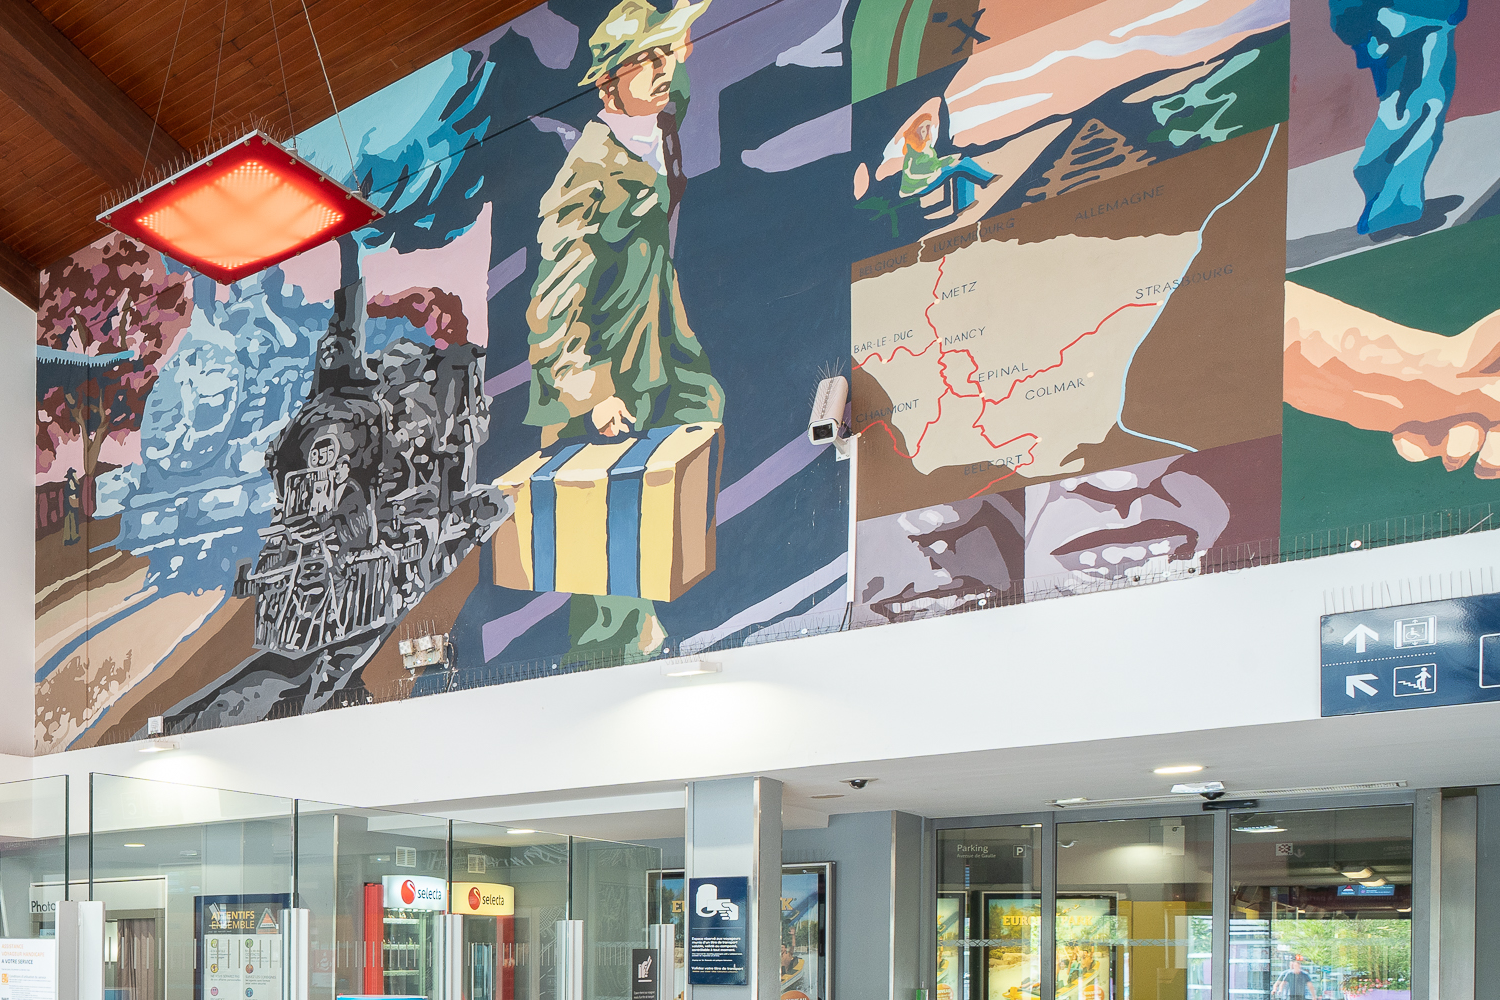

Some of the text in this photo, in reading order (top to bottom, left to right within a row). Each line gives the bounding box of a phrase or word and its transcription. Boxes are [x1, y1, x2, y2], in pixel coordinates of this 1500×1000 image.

[1074, 184, 1165, 223] ALLEMAGNE
[933, 217, 1016, 254] LUXEMBOURG
[858, 252, 909, 278] BELGIQUE
[941, 281, 977, 300] METZ
[1135, 265, 1234, 299] STRASBOURG
[944, 327, 986, 346] NANCY
[977, 361, 1029, 383] EPINAL
[1024, 378, 1085, 401] COLMAR
[855, 398, 919, 424] CHAUMONT
[963, 454, 1022, 476] BELFORT
[957, 844, 1023, 855] Parking P
[417, 888, 442, 900] selecta
[482, 894, 504, 906] selecta
[211, 921, 255, 929] ENEMBLE
[1061, 916, 1093, 926] PARK
